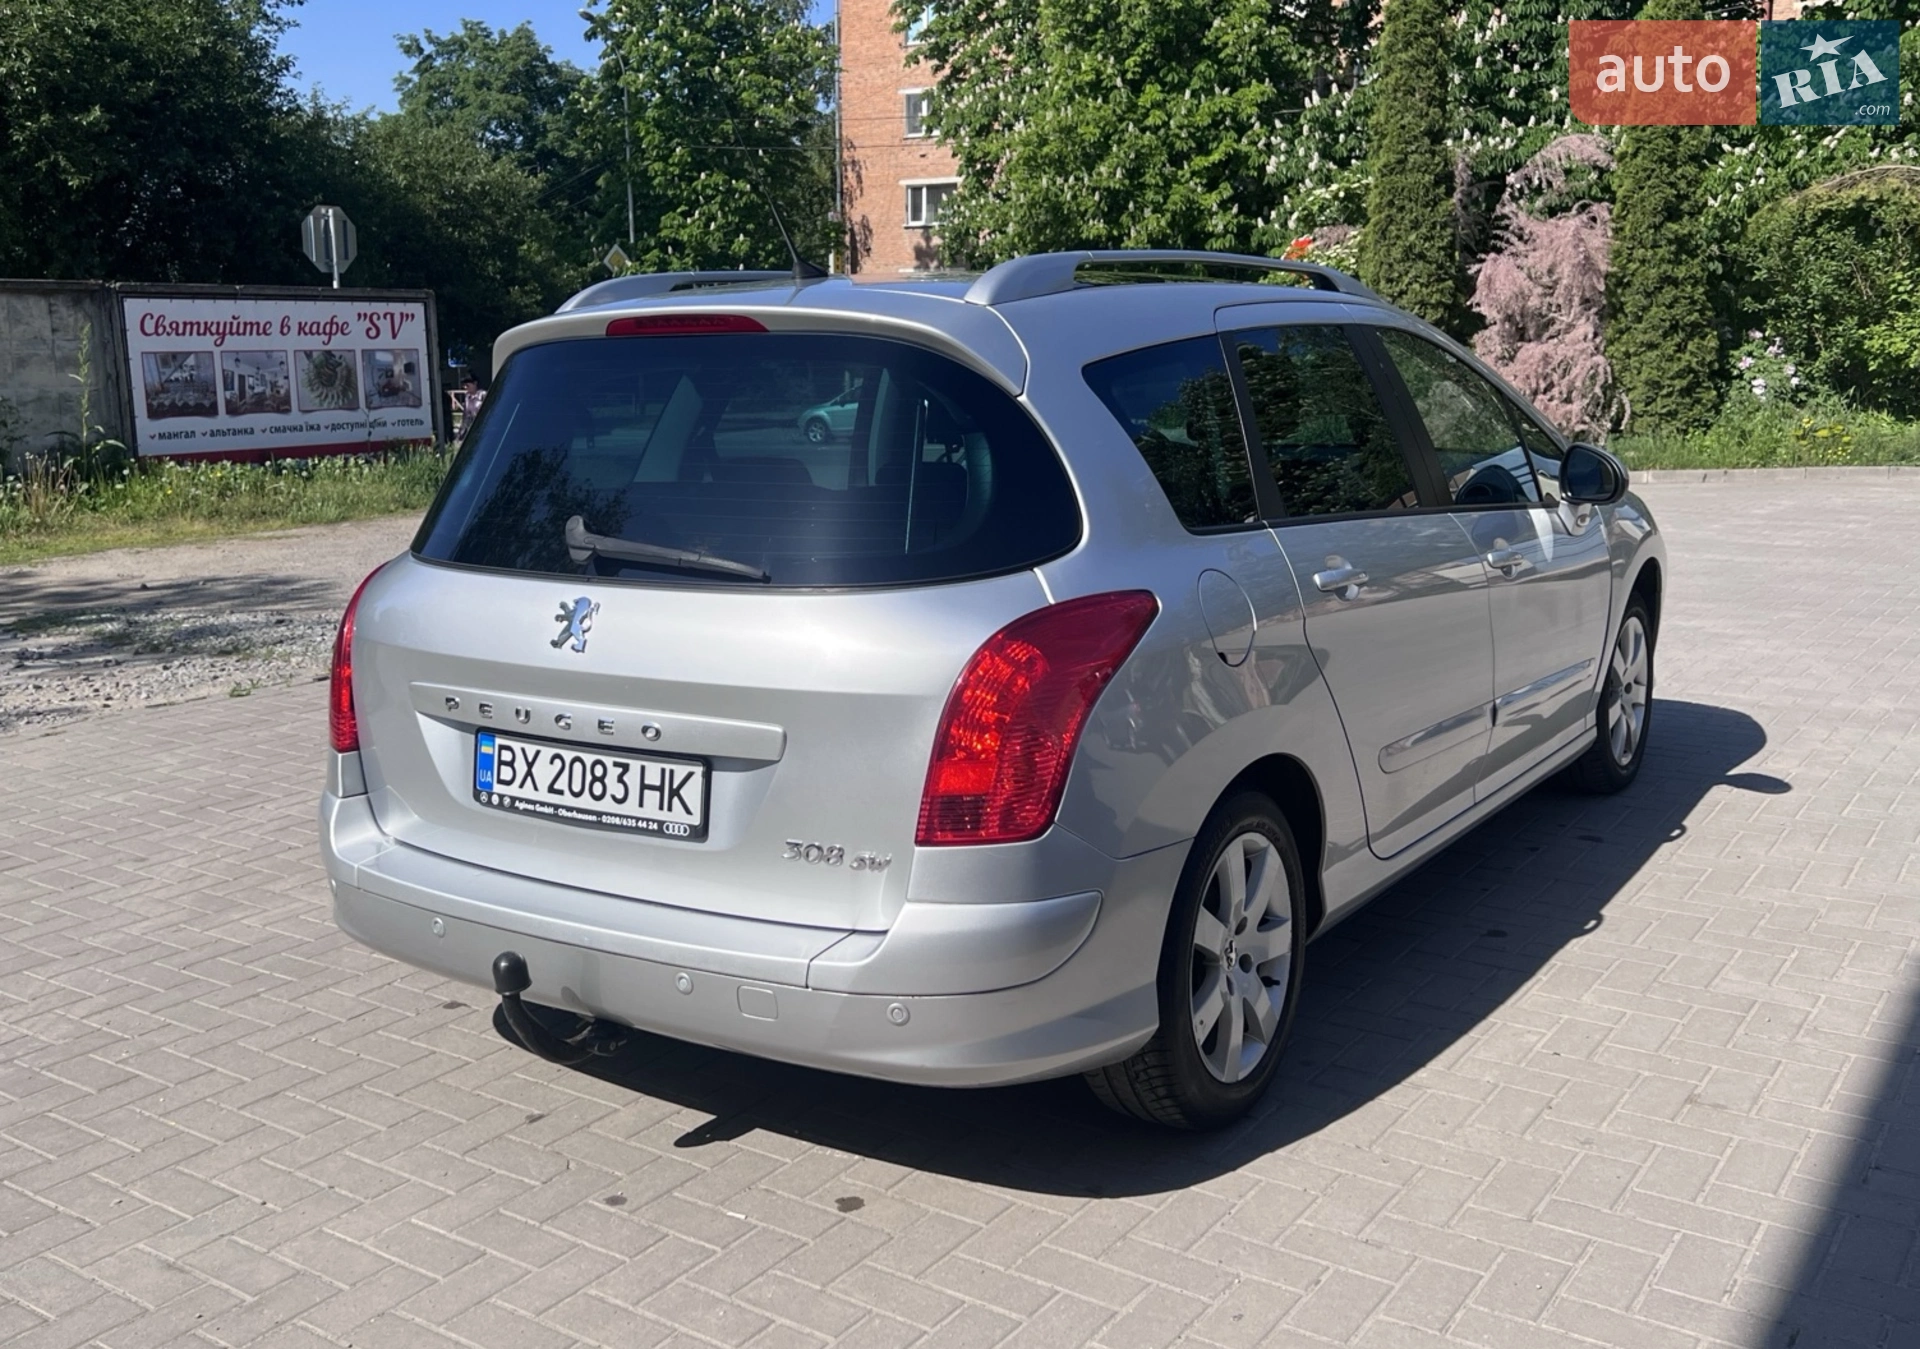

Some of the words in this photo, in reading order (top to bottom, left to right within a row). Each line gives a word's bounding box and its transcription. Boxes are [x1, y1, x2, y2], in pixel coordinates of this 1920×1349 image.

[139, 312, 272, 347] Святкуйте
[279, 316, 291, 336] в
[297, 315, 351, 345] кафе
[158, 430, 196, 440] мангал
[209, 427, 255, 438] альтанка
[269, 424, 304, 435] смачна
[305, 421, 321, 432] їжа
[330, 418, 367, 432] доступні
[397, 418, 424, 428] готель
[445, 696, 662, 742] PEUGEO
[479, 769, 492, 783] UA
[496, 743, 542, 792] BX
[547, 752, 630, 804] 2083
[638, 764, 695, 816] HK
[535, 804, 554, 815] GmbH
[558, 808, 597, 822] Oberhausen
[782, 838, 845, 867] 308
